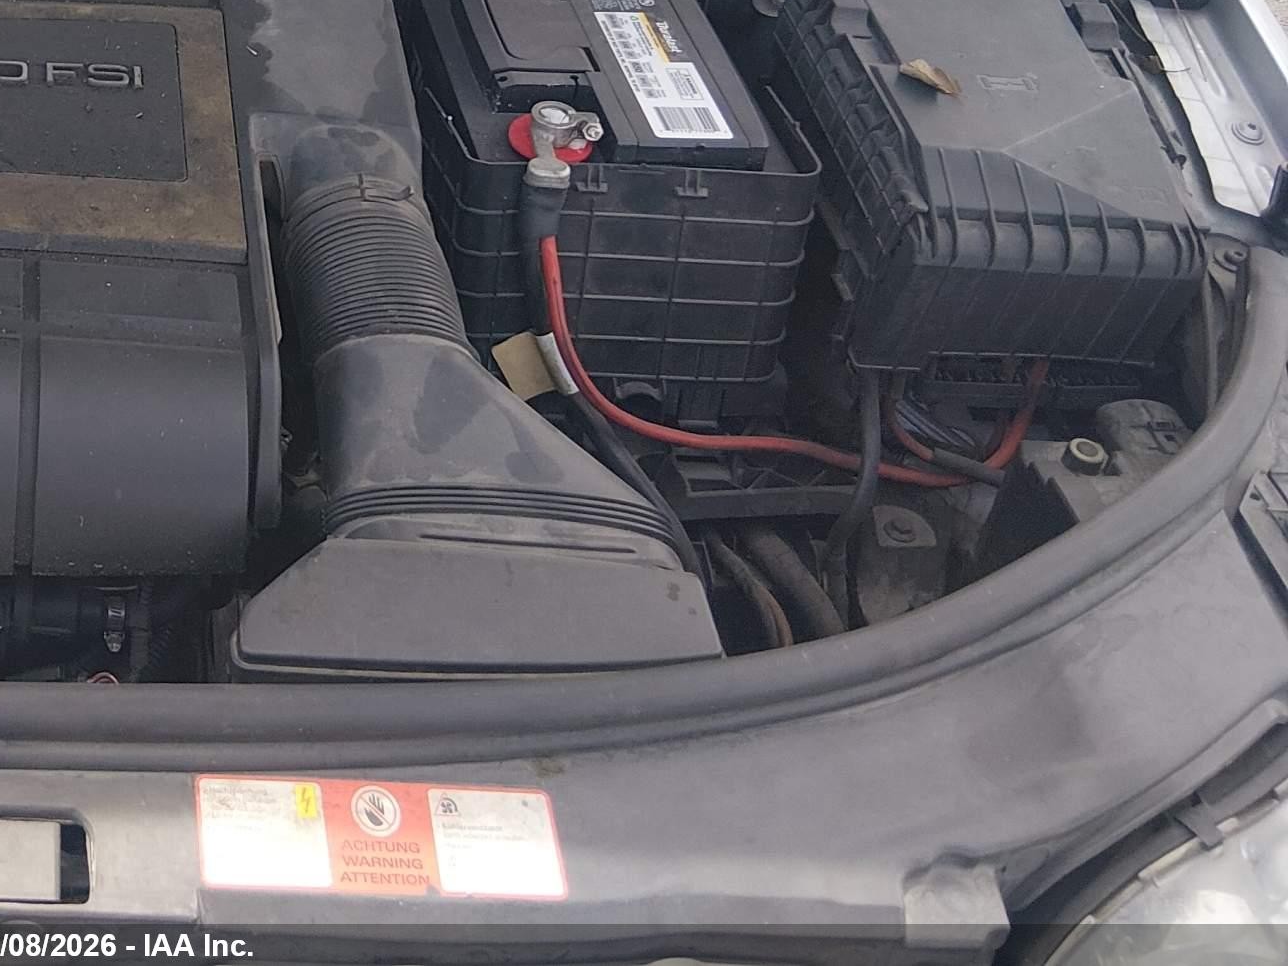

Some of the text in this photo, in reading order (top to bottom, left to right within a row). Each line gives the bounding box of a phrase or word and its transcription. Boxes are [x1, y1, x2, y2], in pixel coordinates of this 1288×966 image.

[46, 62, 144, 88] FSI
[341, 839, 421, 854] ACHTUNG
[342, 855, 424, 869] WARNING
[340, 871, 430, 885] ATTENTION
